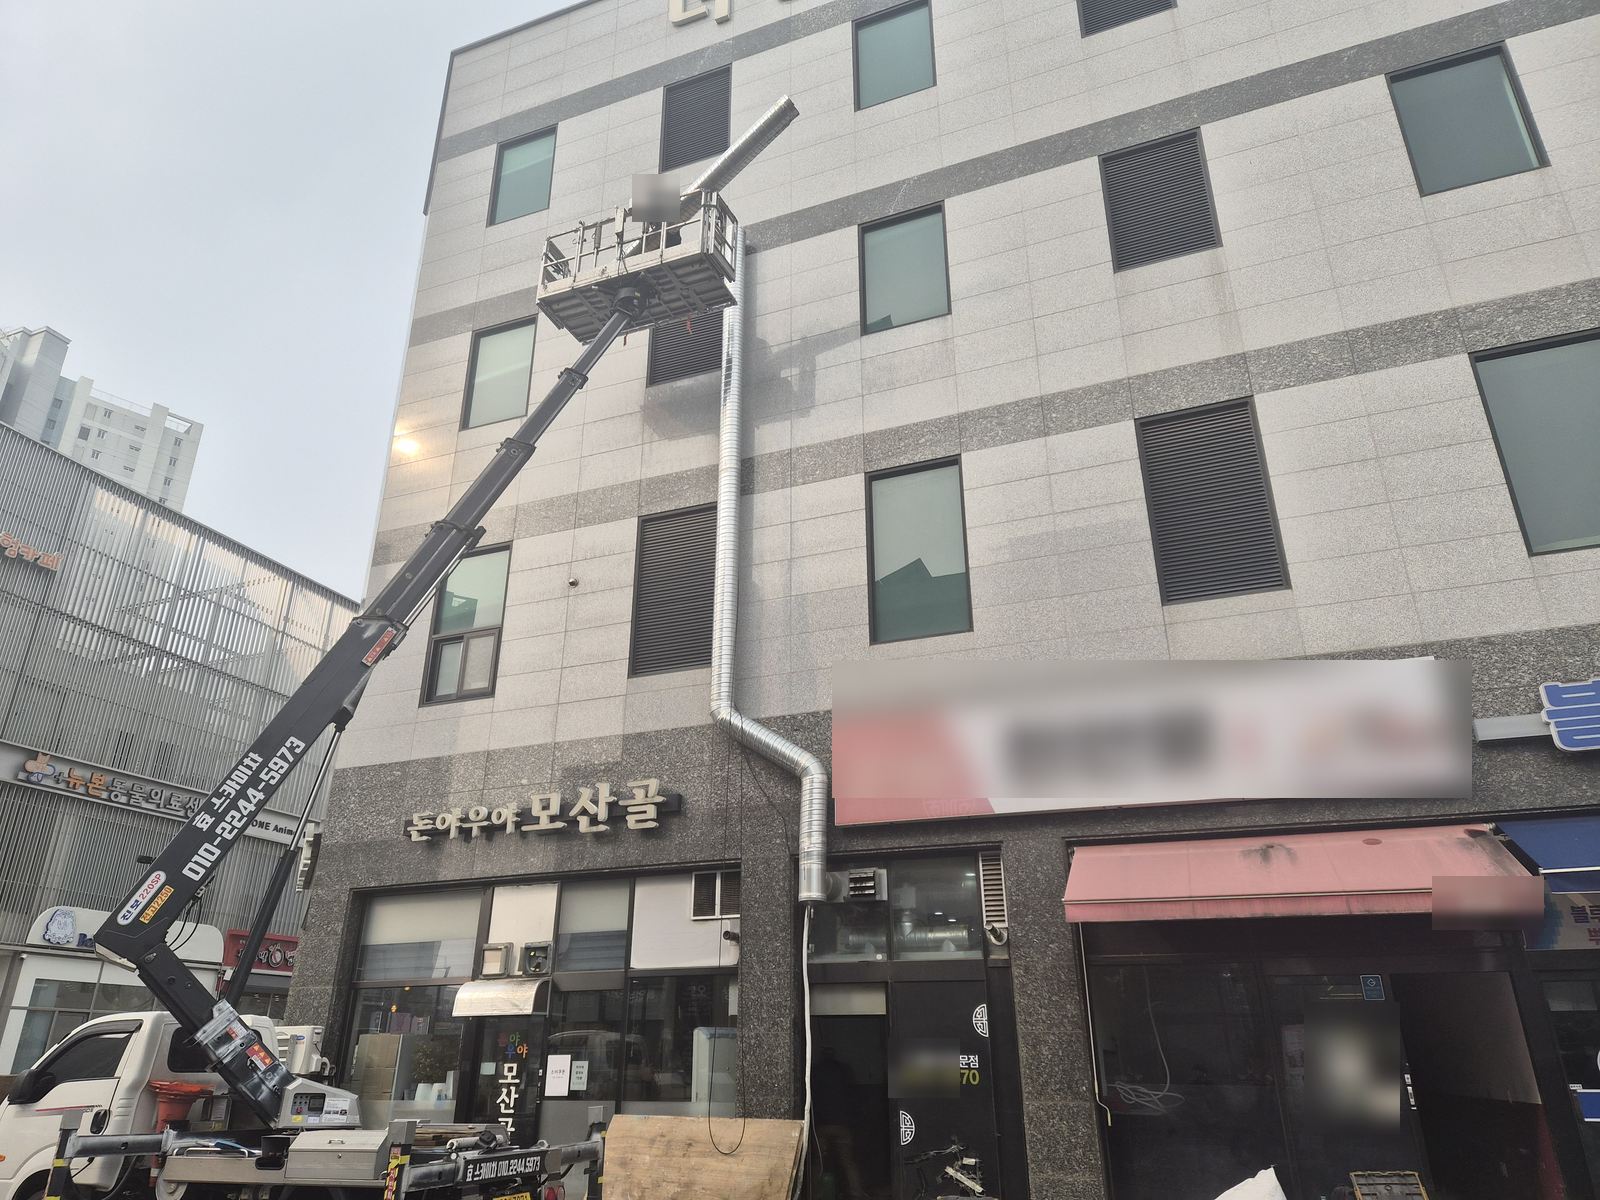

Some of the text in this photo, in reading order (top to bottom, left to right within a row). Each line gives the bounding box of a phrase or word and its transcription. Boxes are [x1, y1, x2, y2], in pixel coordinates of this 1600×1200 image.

[192, 752, 264, 832] 효 스카이차
[521, 778, 667, 833] 모산골
[181, 736, 306, 882] 010-2244-5973
[273, 824, 296, 836] Anim
[138, 873, 163, 901] 220SP
[504, 1043, 529, 1059] 우야
[465, 1164, 474, 1182] 효
[474, 1161, 498, 1181] 스카이차
